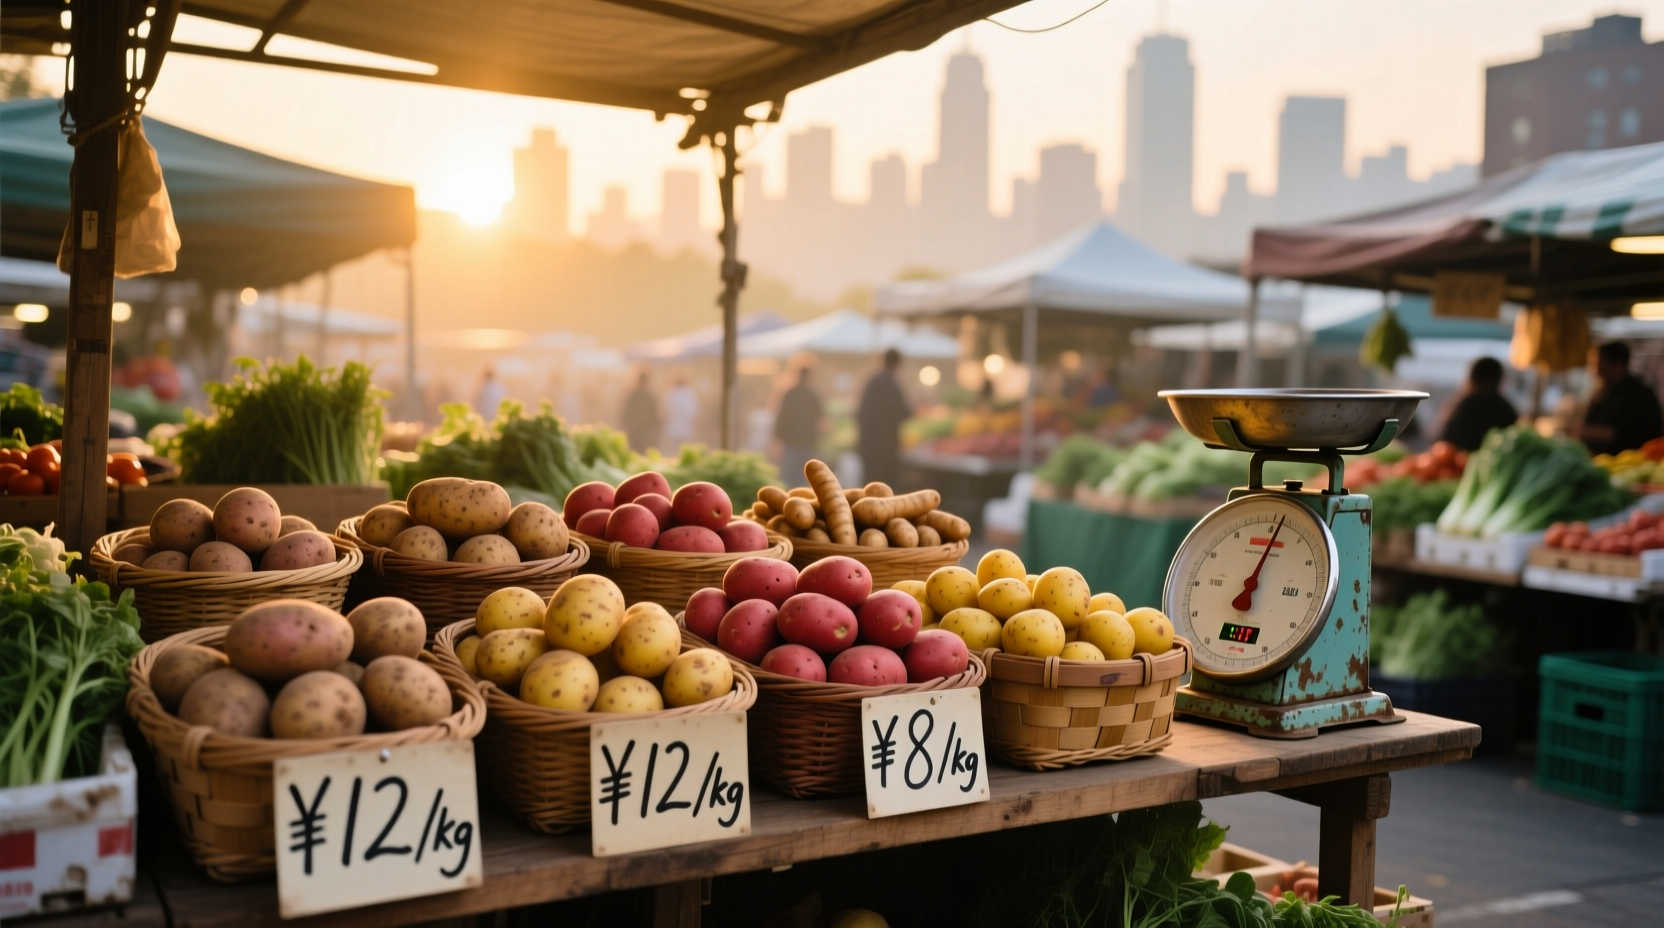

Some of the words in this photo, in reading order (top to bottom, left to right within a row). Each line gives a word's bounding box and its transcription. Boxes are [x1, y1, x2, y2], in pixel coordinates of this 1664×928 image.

[600, 740, 744, 828] ¥12/kg
[871, 709, 979, 793] ¥8/kg
[289, 777, 474, 880] ¥12/kg
